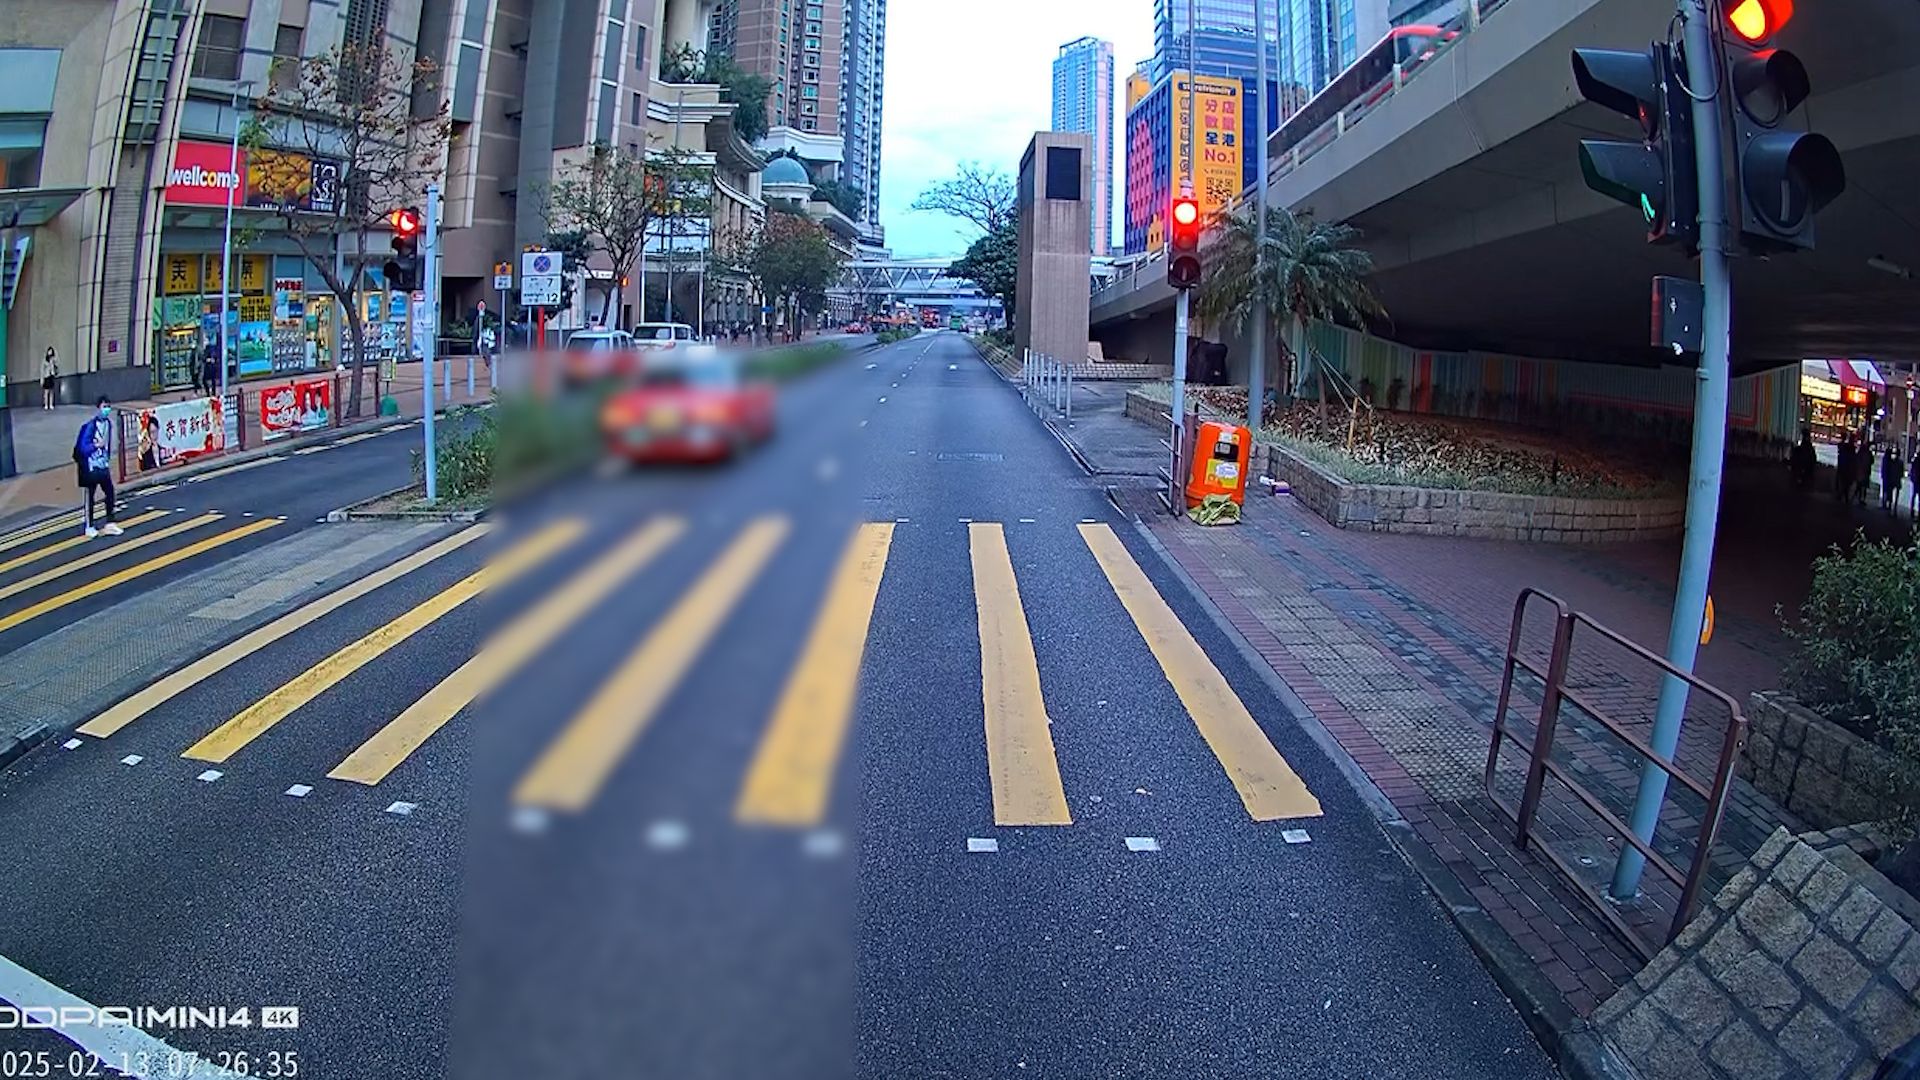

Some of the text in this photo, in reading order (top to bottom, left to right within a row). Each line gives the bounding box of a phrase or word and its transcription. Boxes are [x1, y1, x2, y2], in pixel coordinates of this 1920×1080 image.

[1205, 99, 1236, 114] 分店
[1205, 148, 1235, 164] No.1
[171, 165, 240, 189] wellcome
[547, 293, 558, 302] 12
[166, 411, 211, 440] 恭賀新禧
